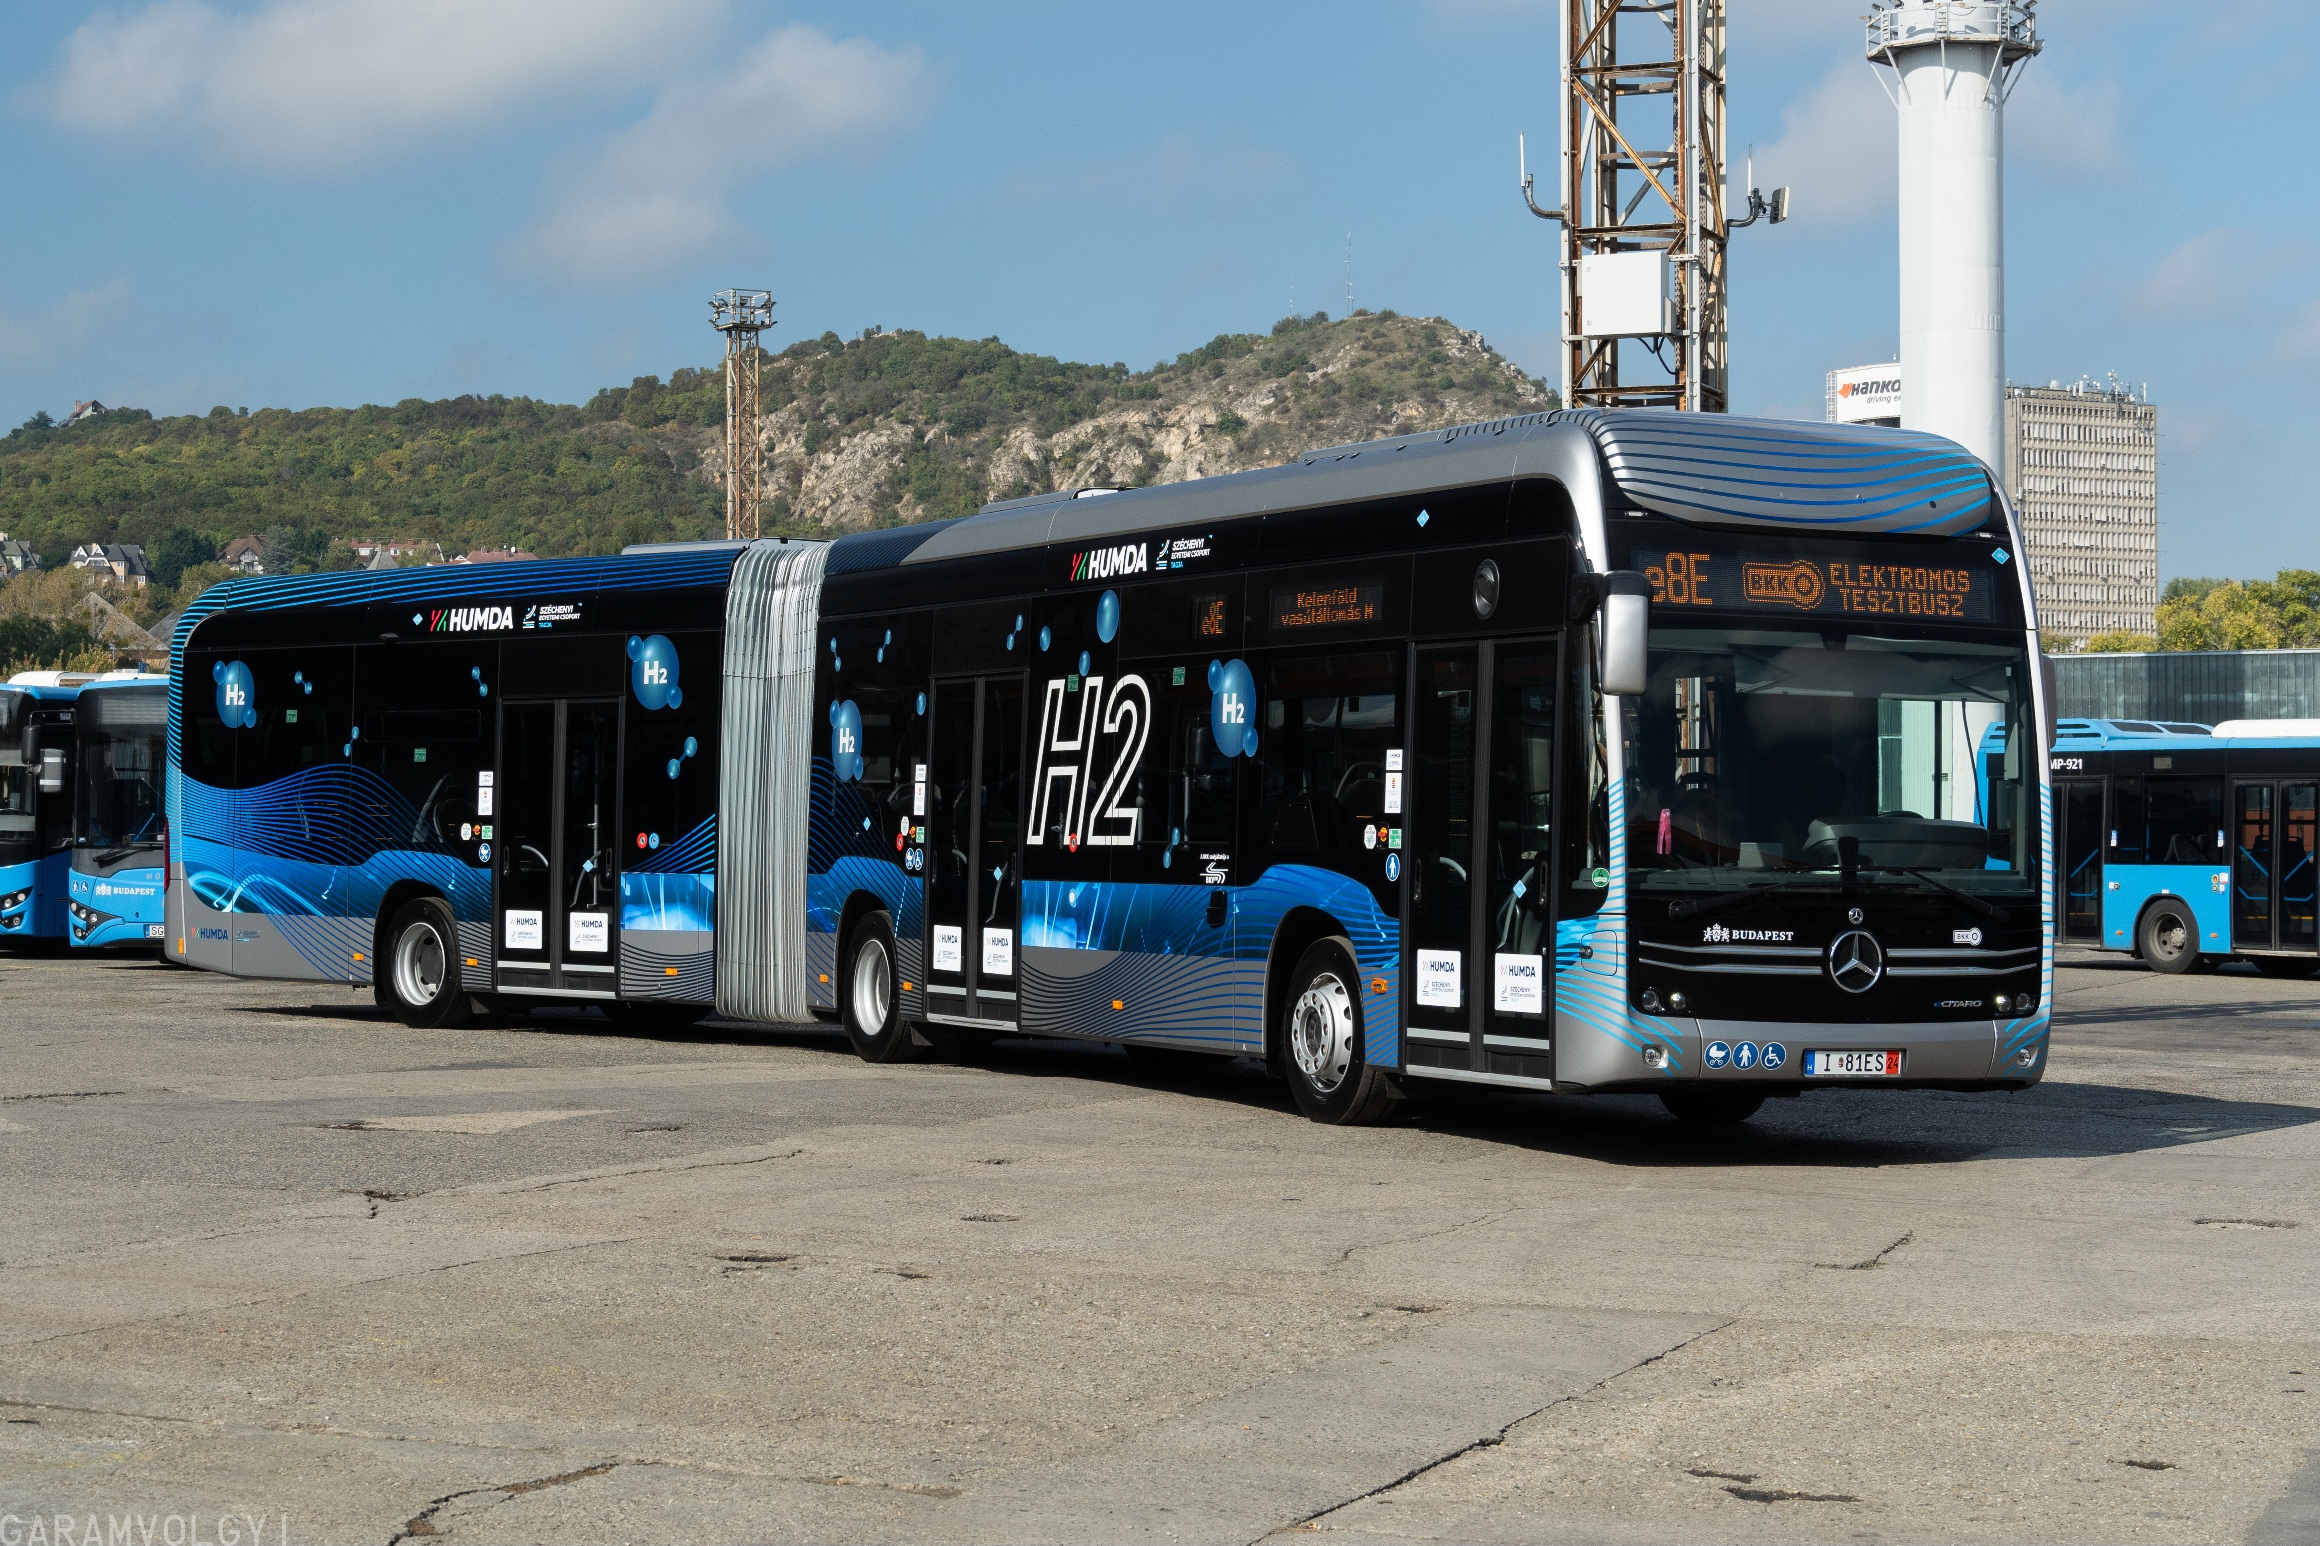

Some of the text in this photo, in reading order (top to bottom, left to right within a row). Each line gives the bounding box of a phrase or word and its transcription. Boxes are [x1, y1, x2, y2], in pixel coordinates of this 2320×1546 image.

[1867, 395, 1891, 403] driving
[1172, 538, 1204, 551] SZÉCHENYI
[1087, 543, 1147, 579] HUMDA
[1645, 552, 1712, 605] e8E
[1751, 573, 1789, 592] BKK
[1829, 563, 1970, 593] ELEKTROMOS
[1297, 587, 1357, 608] Kelenföld
[1839, 588, 1964, 616] TESZTBUSZ
[540, 605, 573, 614] SZÉCHENYI
[449, 606, 513, 631] HUMDA
[643, 660, 667, 684] H2
[225, 684, 245, 705] H2
[1222, 693, 1245, 723] H2
[839, 728, 854, 753] H2
[1027, 674, 1150, 845] H2
[113, 887, 155, 895] BUDAPEST
[151, 927, 164, 935] SG
[582, 920, 602, 928] HUMDA
[200, 928, 228, 940] HUMDA
[941, 934, 957, 944] HUMDA
[991, 937, 1008, 946] HUMDA
[1732, 930, 1793, 941] BUDAPEST
[1430, 961, 1455, 972] HUMDA
[1509, 965, 1536, 977] HUMDA
[1846, 1054, 1883, 1071] 81ES
[1888, 1057, 1898, 1069] 24
